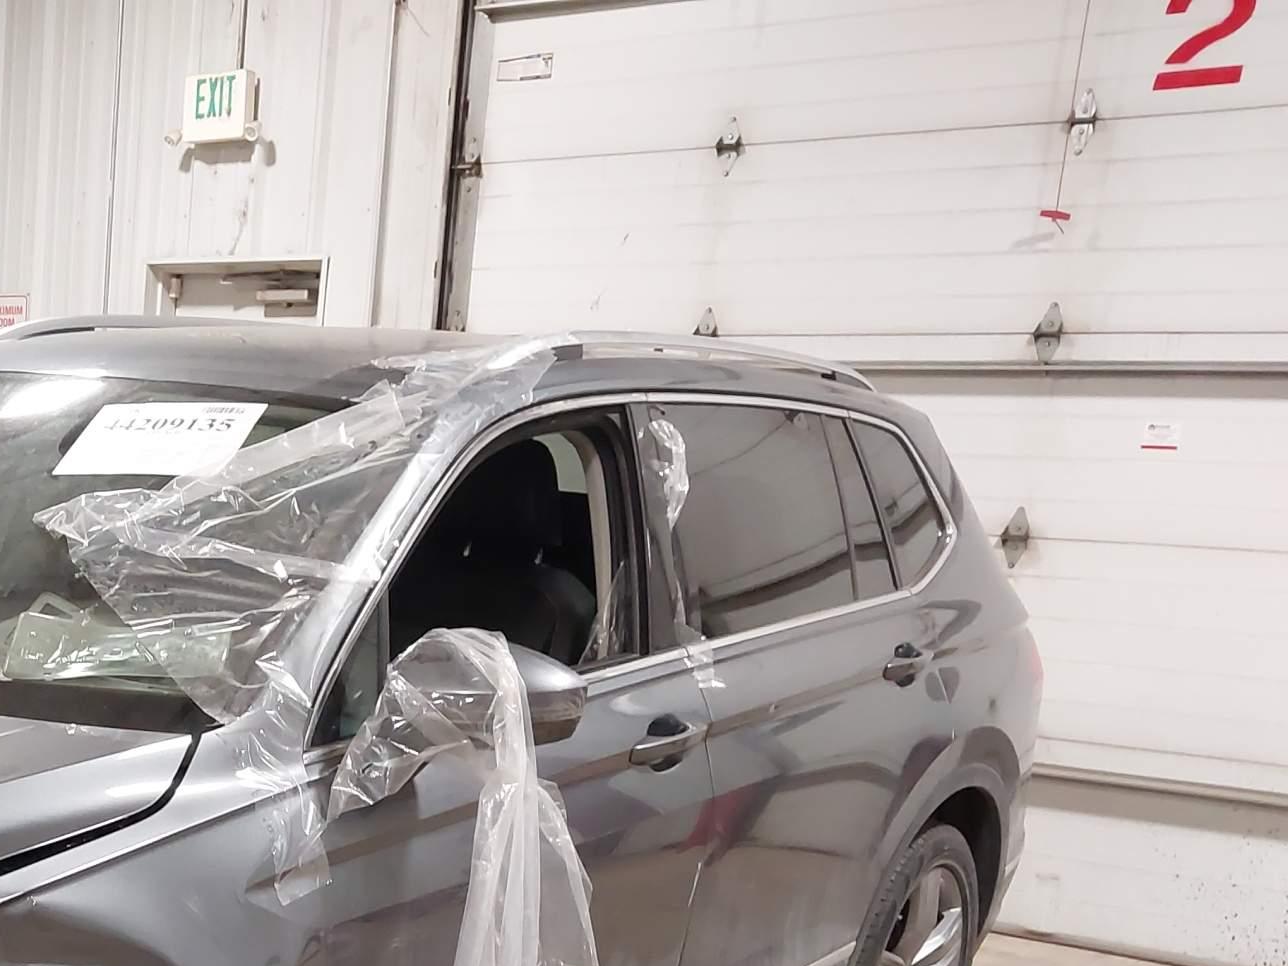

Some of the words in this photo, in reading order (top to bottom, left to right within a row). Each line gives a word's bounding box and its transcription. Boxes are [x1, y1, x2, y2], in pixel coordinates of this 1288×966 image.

[1153, 0, 1257, 91] 2
[195, 75, 236, 120] EXIT
[103, 417, 236, 432] 44209135
